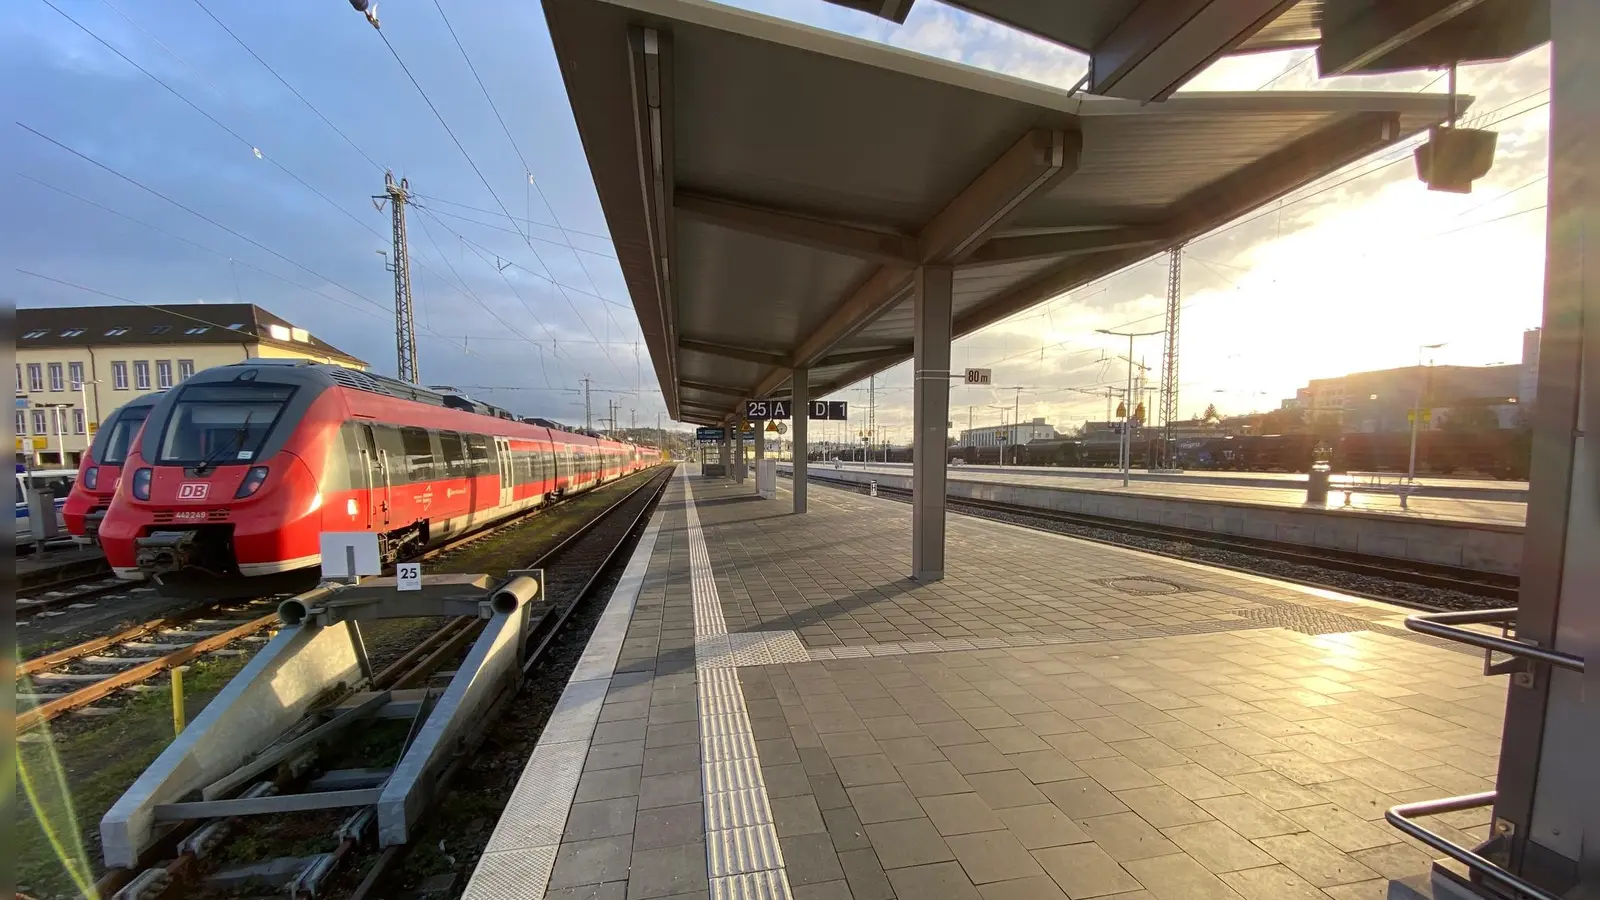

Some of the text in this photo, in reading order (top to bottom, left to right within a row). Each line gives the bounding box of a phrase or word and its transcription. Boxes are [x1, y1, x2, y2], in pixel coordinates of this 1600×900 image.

[968, 370, 979, 382] 80
[749, 402, 785, 416] 25 A
[816, 402, 846, 416] D 1
[179, 484, 208, 498] DB
[400, 568, 417, 579] 25
